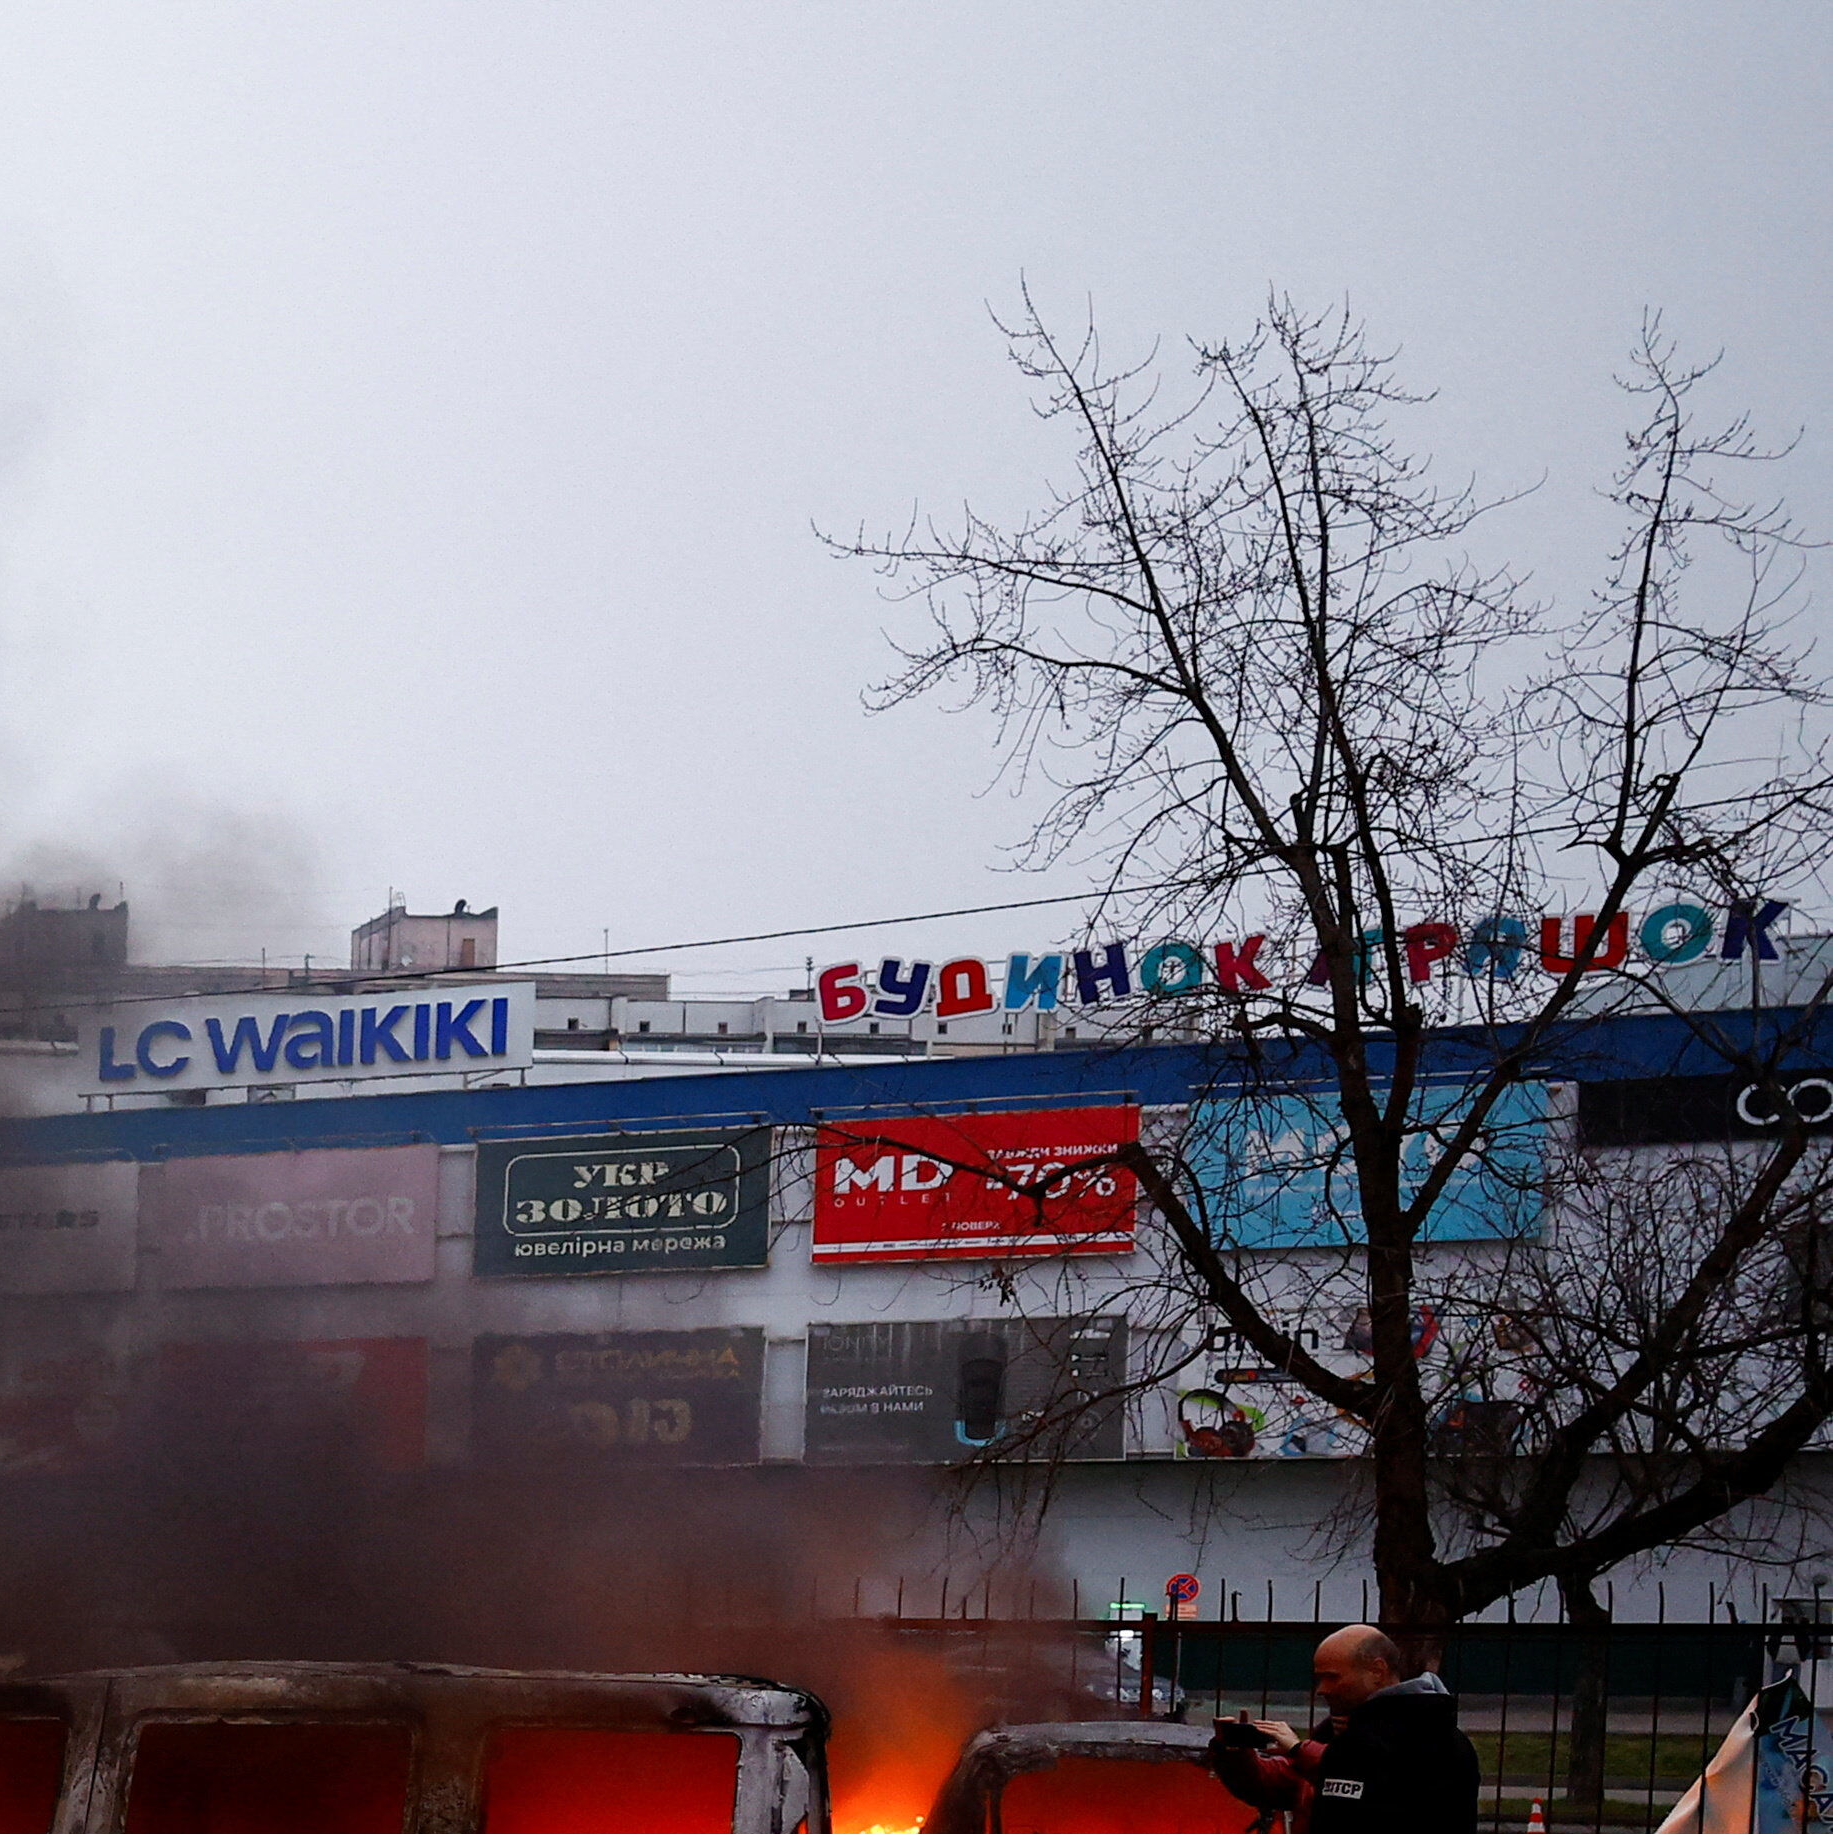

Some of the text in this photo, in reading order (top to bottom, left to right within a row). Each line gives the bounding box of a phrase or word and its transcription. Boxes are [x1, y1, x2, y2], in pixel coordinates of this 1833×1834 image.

[817, 934, 1273, 1022] БУДИНОК
[98, 1020, 192, 1082] LC
[1053, 1143, 1118, 1157] ЗНИЖКИ
[573, 1161, 670, 1189] УКР
[833, 1154, 955, 1195] MD
[985, 1160, 1117, 1201] -70%
[516, 1191, 728, 1224] ЗОЛОТО
[514, 1234, 726, 1259] ювелірна мережа
[1207, 1321, 1319, 1351] brin
[822, 1384, 934, 1398] ЗАРЯДЖАЙТЕСЬ
[883, 1400, 925, 1412] НАМИ
